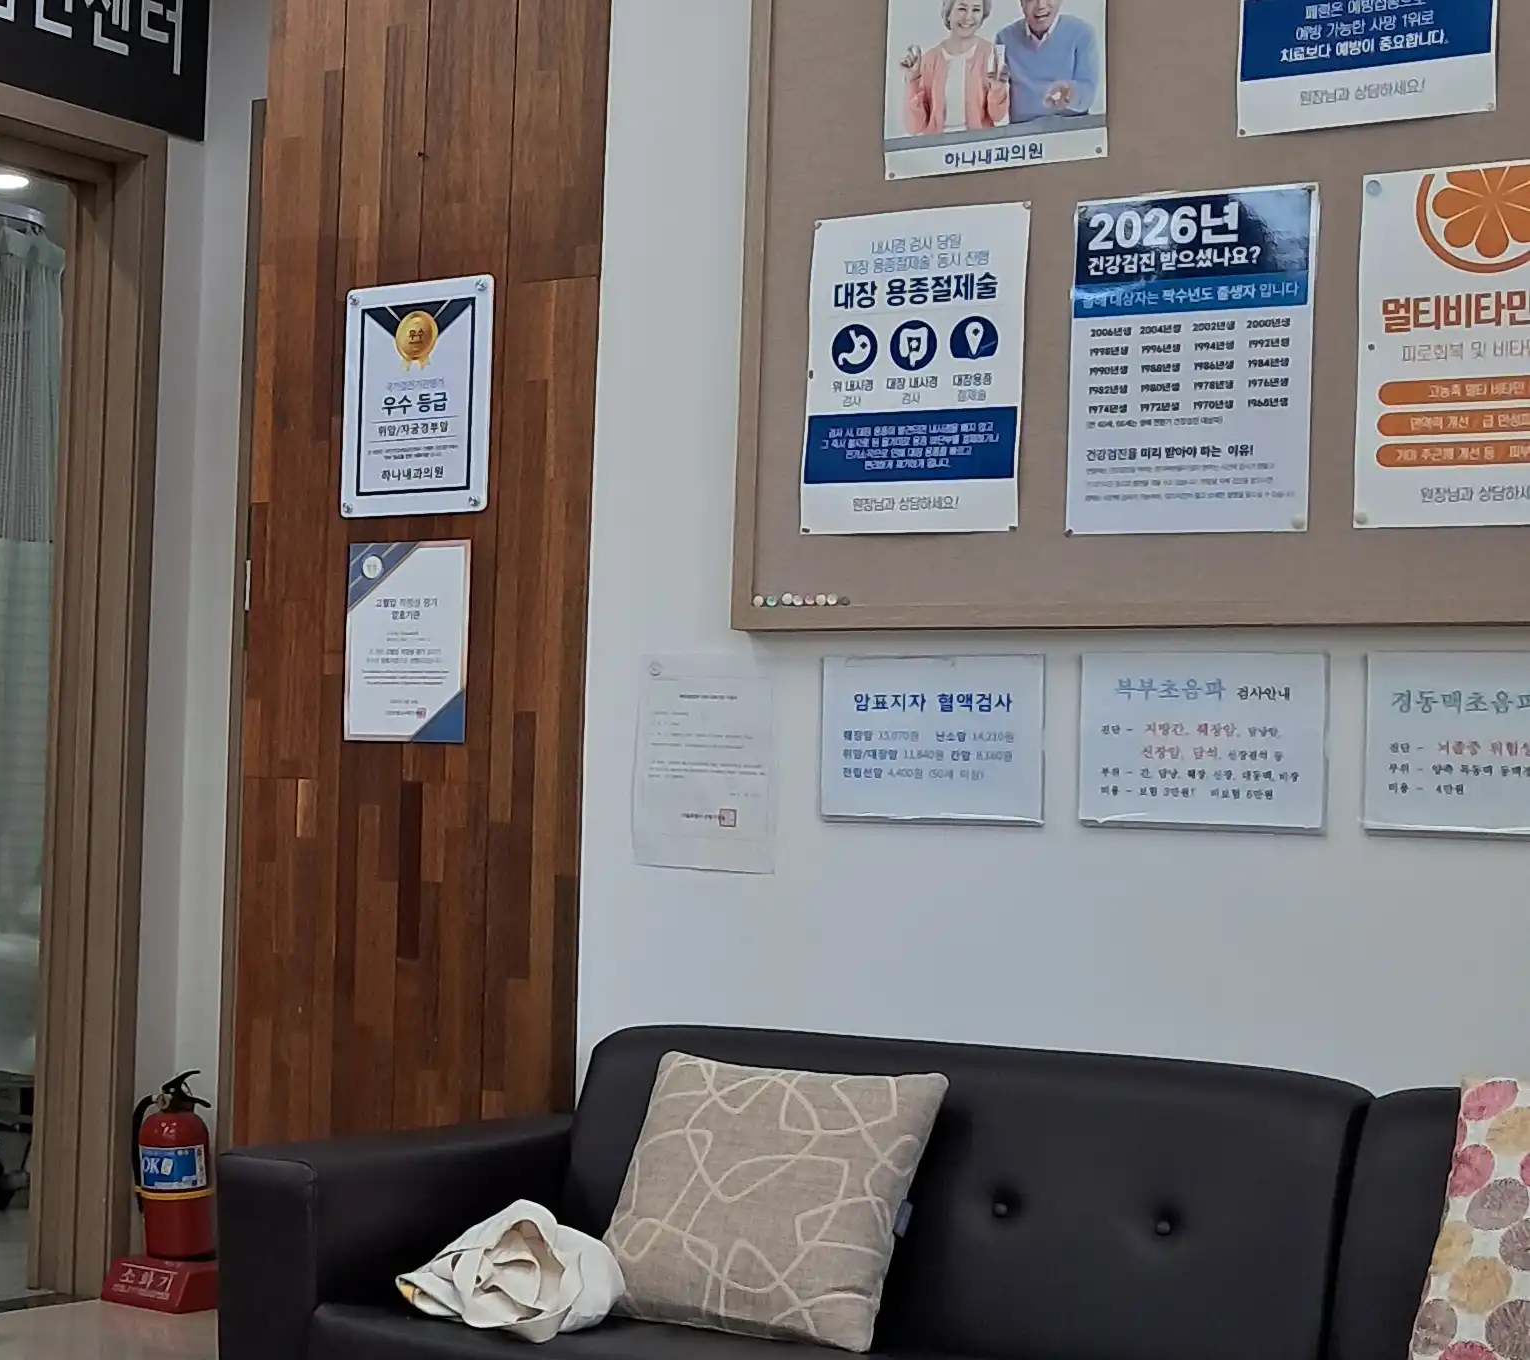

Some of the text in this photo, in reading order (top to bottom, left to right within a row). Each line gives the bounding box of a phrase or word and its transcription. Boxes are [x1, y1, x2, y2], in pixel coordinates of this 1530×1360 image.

[1295, 9, 1435, 41] 예방 가능한 사망 1위로
[1279, 43, 1331, 63] 치료보다
[1335, 38, 1375, 57] 예방이
[1299, 77, 1426, 106] 원장님과 상담하세요!
[1088, 201, 1239, 251] 2026년
[1088, 245, 1261, 276] 건강검진 받으셨나요?
[833, 271, 998, 309] 대장 용종절제술
[1110, 290, 1159, 307] 대상자는
[1162, 287, 1214, 303] 짝수년도
[1217, 284, 1256, 301] 출생자
[1259, 281, 1300, 298] 입니다
[1382, 290, 1530, 333] 멀티비타민
[1090, 318, 1291, 338] 2006년생 2004년생 2002년생 2000년생
[1089, 337, 1290, 357] 1998년생 1996년생 1994년생 1992년생
[1402, 342, 1464, 362] 피로회복
[1089, 365, 1129, 376] 1990년생
[1193, 360, 1235, 372] 1986년생
[1248, 357, 1290, 369] 1984년생
[1193, 379, 1234, 391] 1978년생
[1247, 377, 1289, 388] 1976년생
[381, 392, 448, 416] 우수 등급
[1088, 404, 1128, 415] 1974년생
[1140, 401, 1180, 413] 1972년생
[1193, 399, 1234, 410] 1970년생
[1086, 444, 1254, 461] 건강검진을 미리 받아야 하는 이유!
[381, 466, 444, 481] 하나내과의원
[1420, 486, 1474, 503] 원장님과
[853, 693, 1013, 713] 암표지자 혈액검사
[119, 1268, 174, 1292] 소화기
